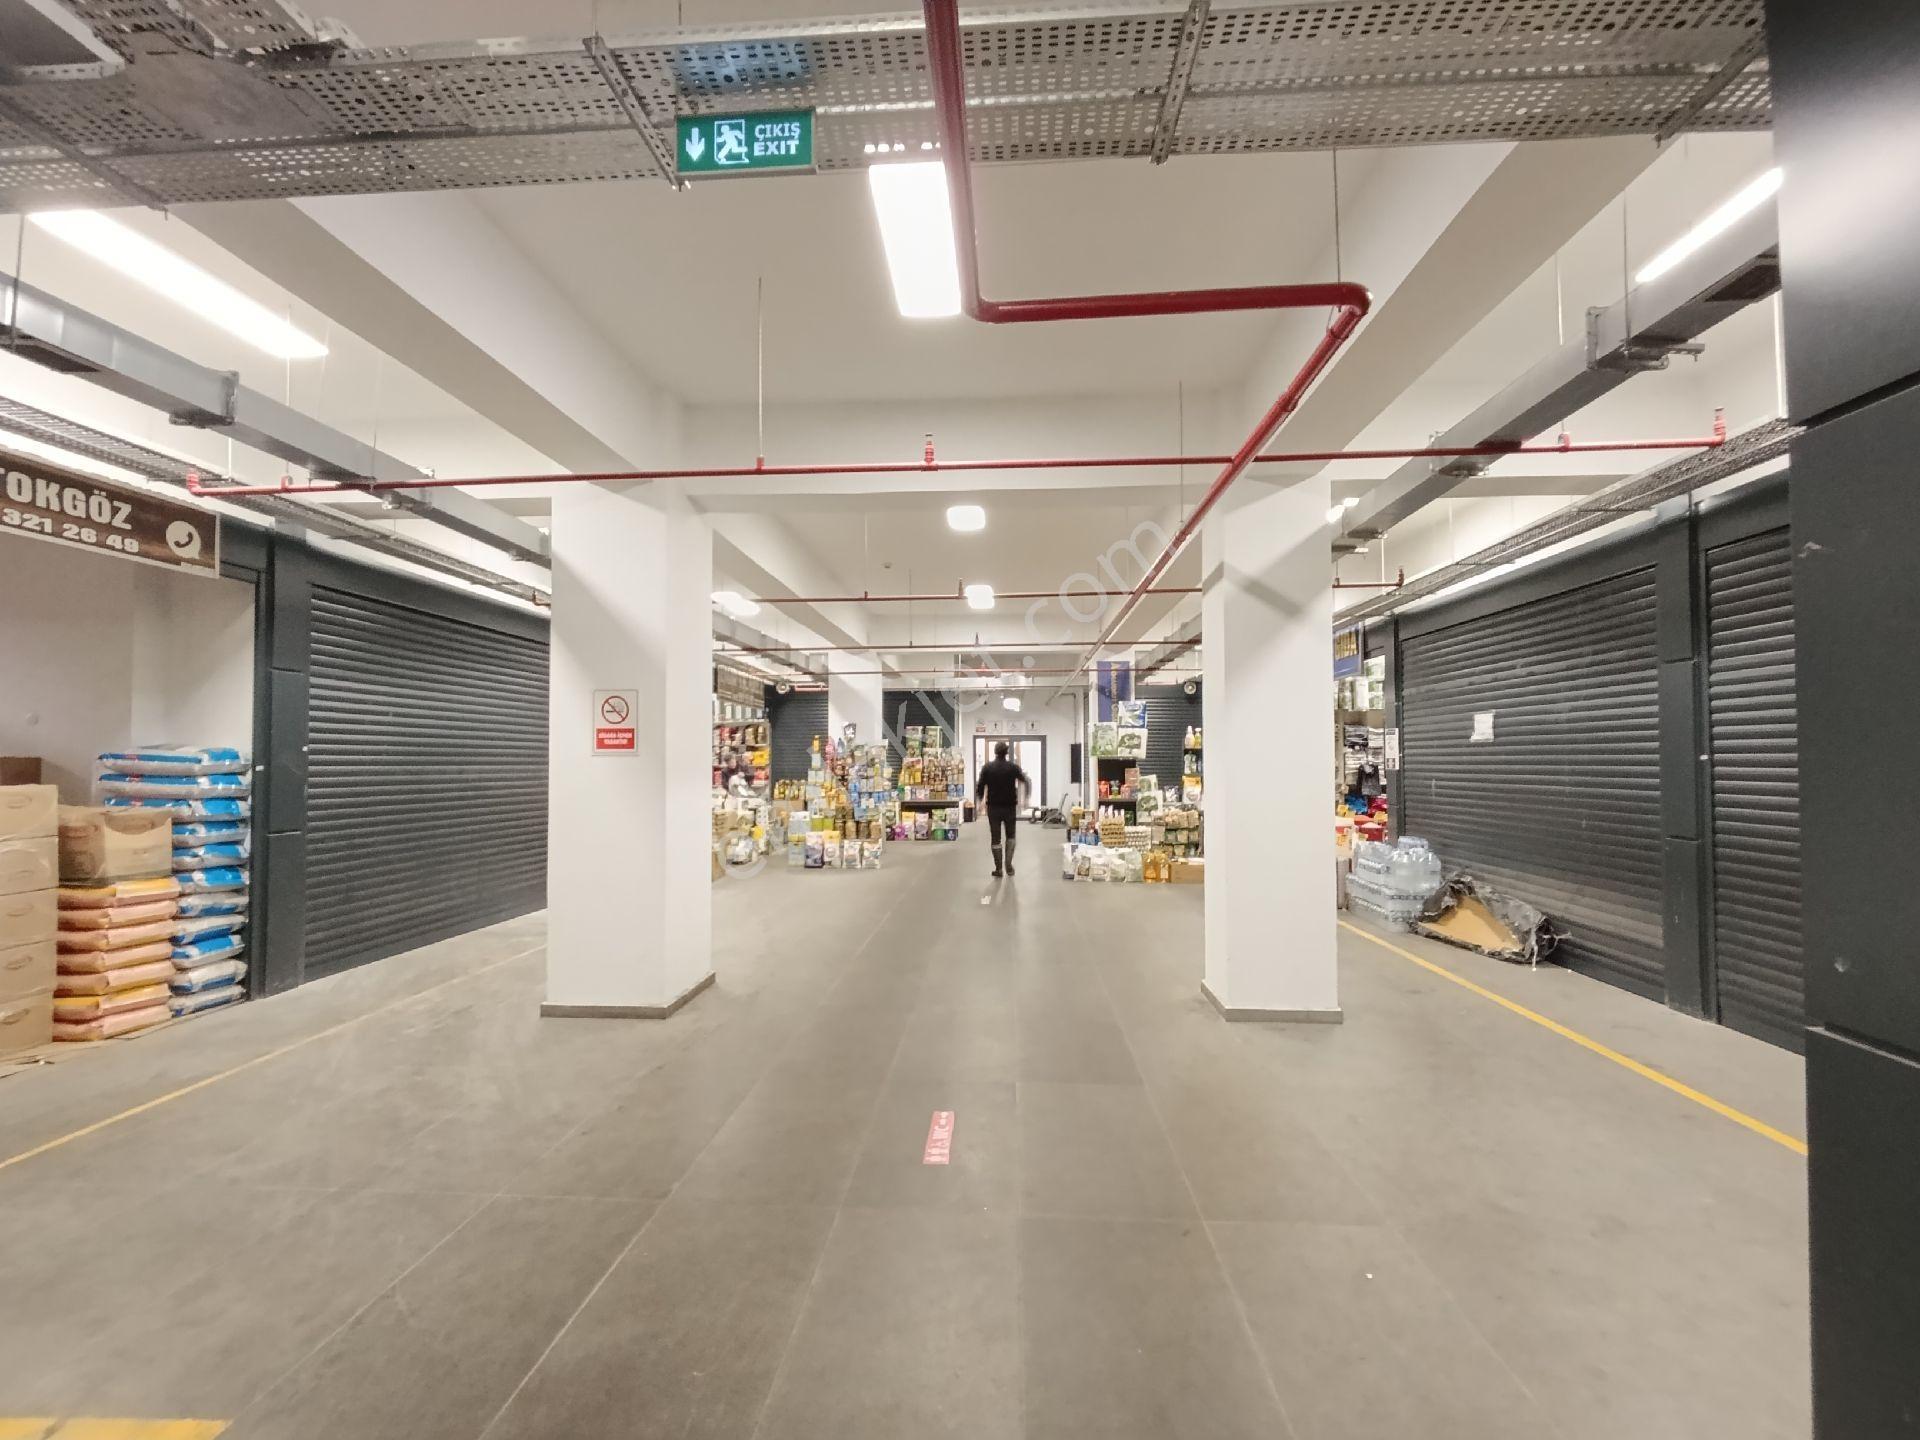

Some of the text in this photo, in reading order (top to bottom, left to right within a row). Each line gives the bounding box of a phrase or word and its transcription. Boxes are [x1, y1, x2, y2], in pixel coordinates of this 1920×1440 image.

[755, 122, 801, 141] ÇIKIŞ
[753, 139, 800, 157] EXIT
[0, 467, 133, 530] OKGÖZ
[2, 508, 53, 534] 321
[62, 523, 98, 543] 26
